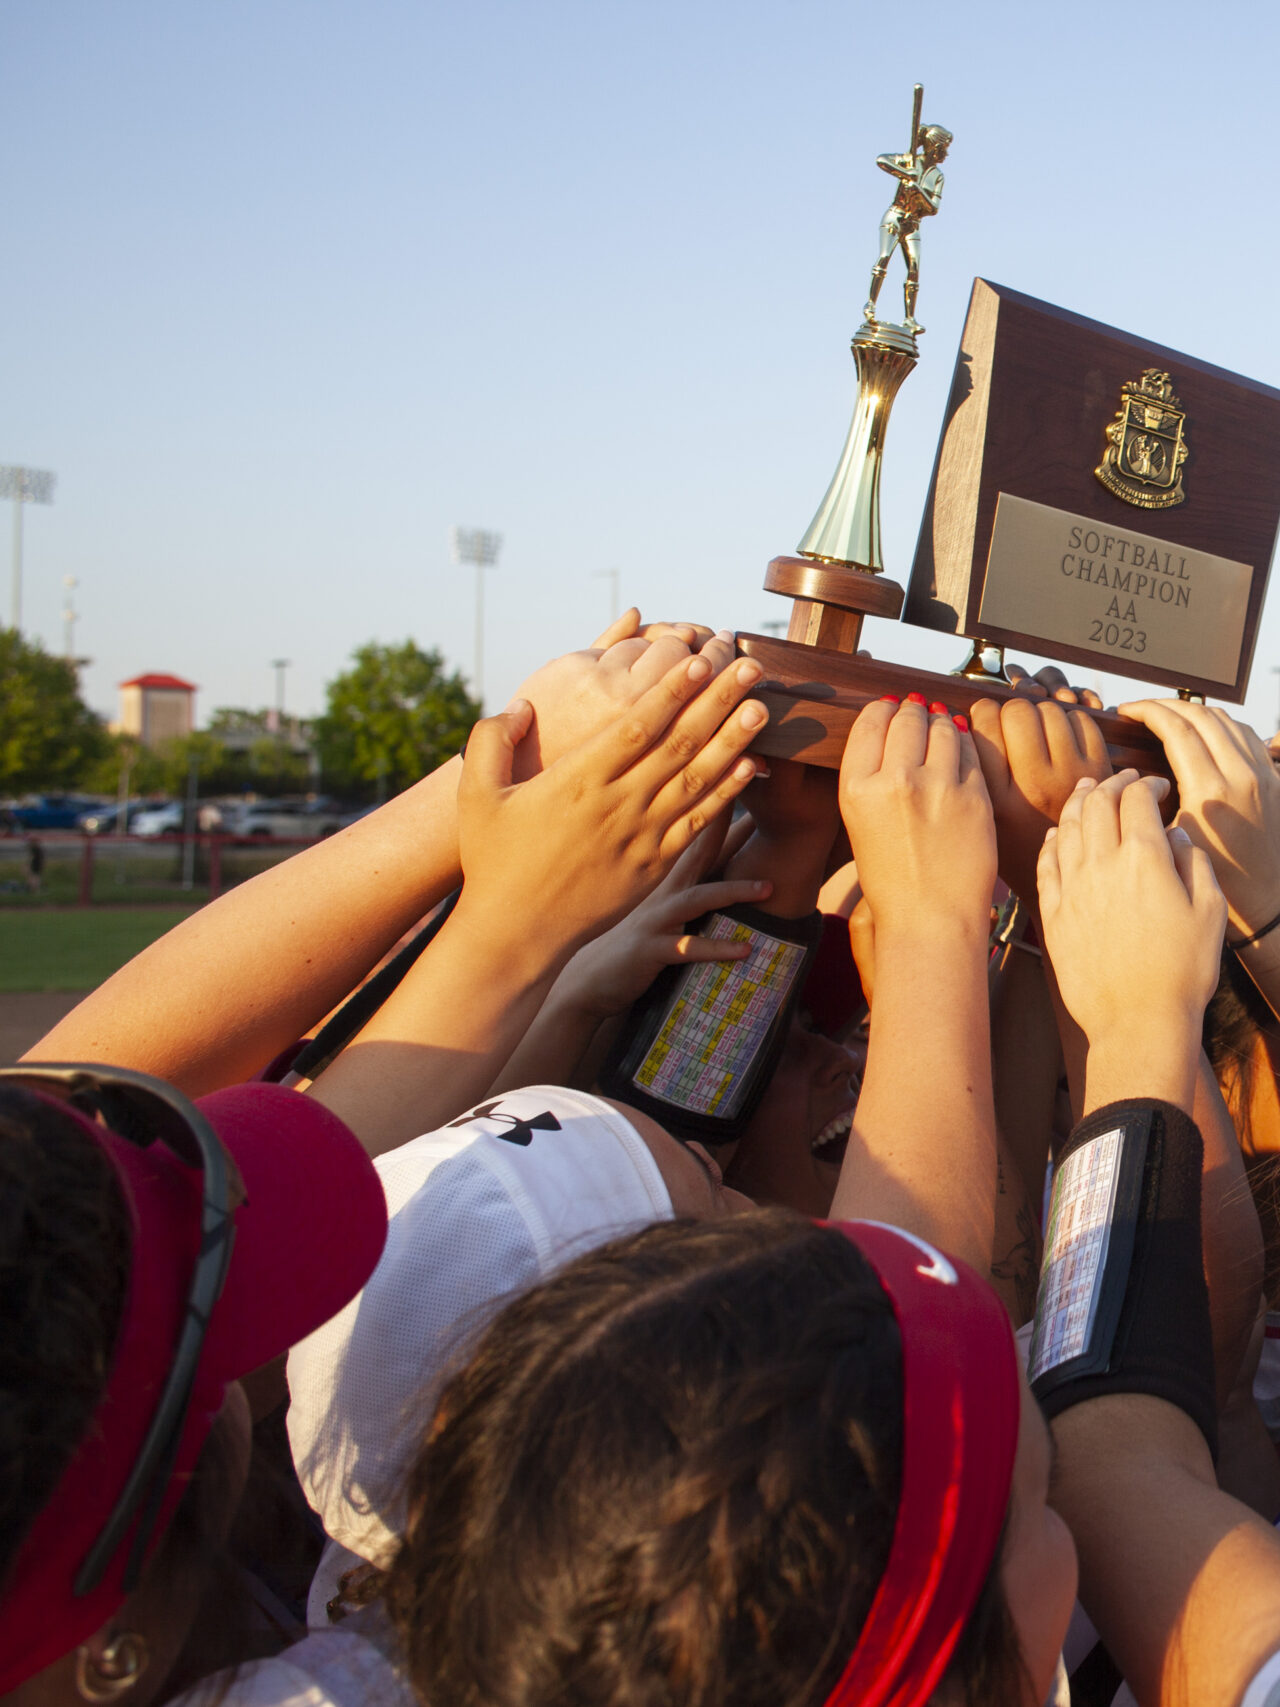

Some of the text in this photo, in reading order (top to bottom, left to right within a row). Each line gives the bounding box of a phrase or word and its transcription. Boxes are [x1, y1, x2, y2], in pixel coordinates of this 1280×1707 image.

[1068, 526, 1190, 580] SOFTBALL
[1061, 554, 1192, 608] CHAMPION
[1105, 595, 1138, 623] AA
[1088, 620, 1148, 653] 2023
